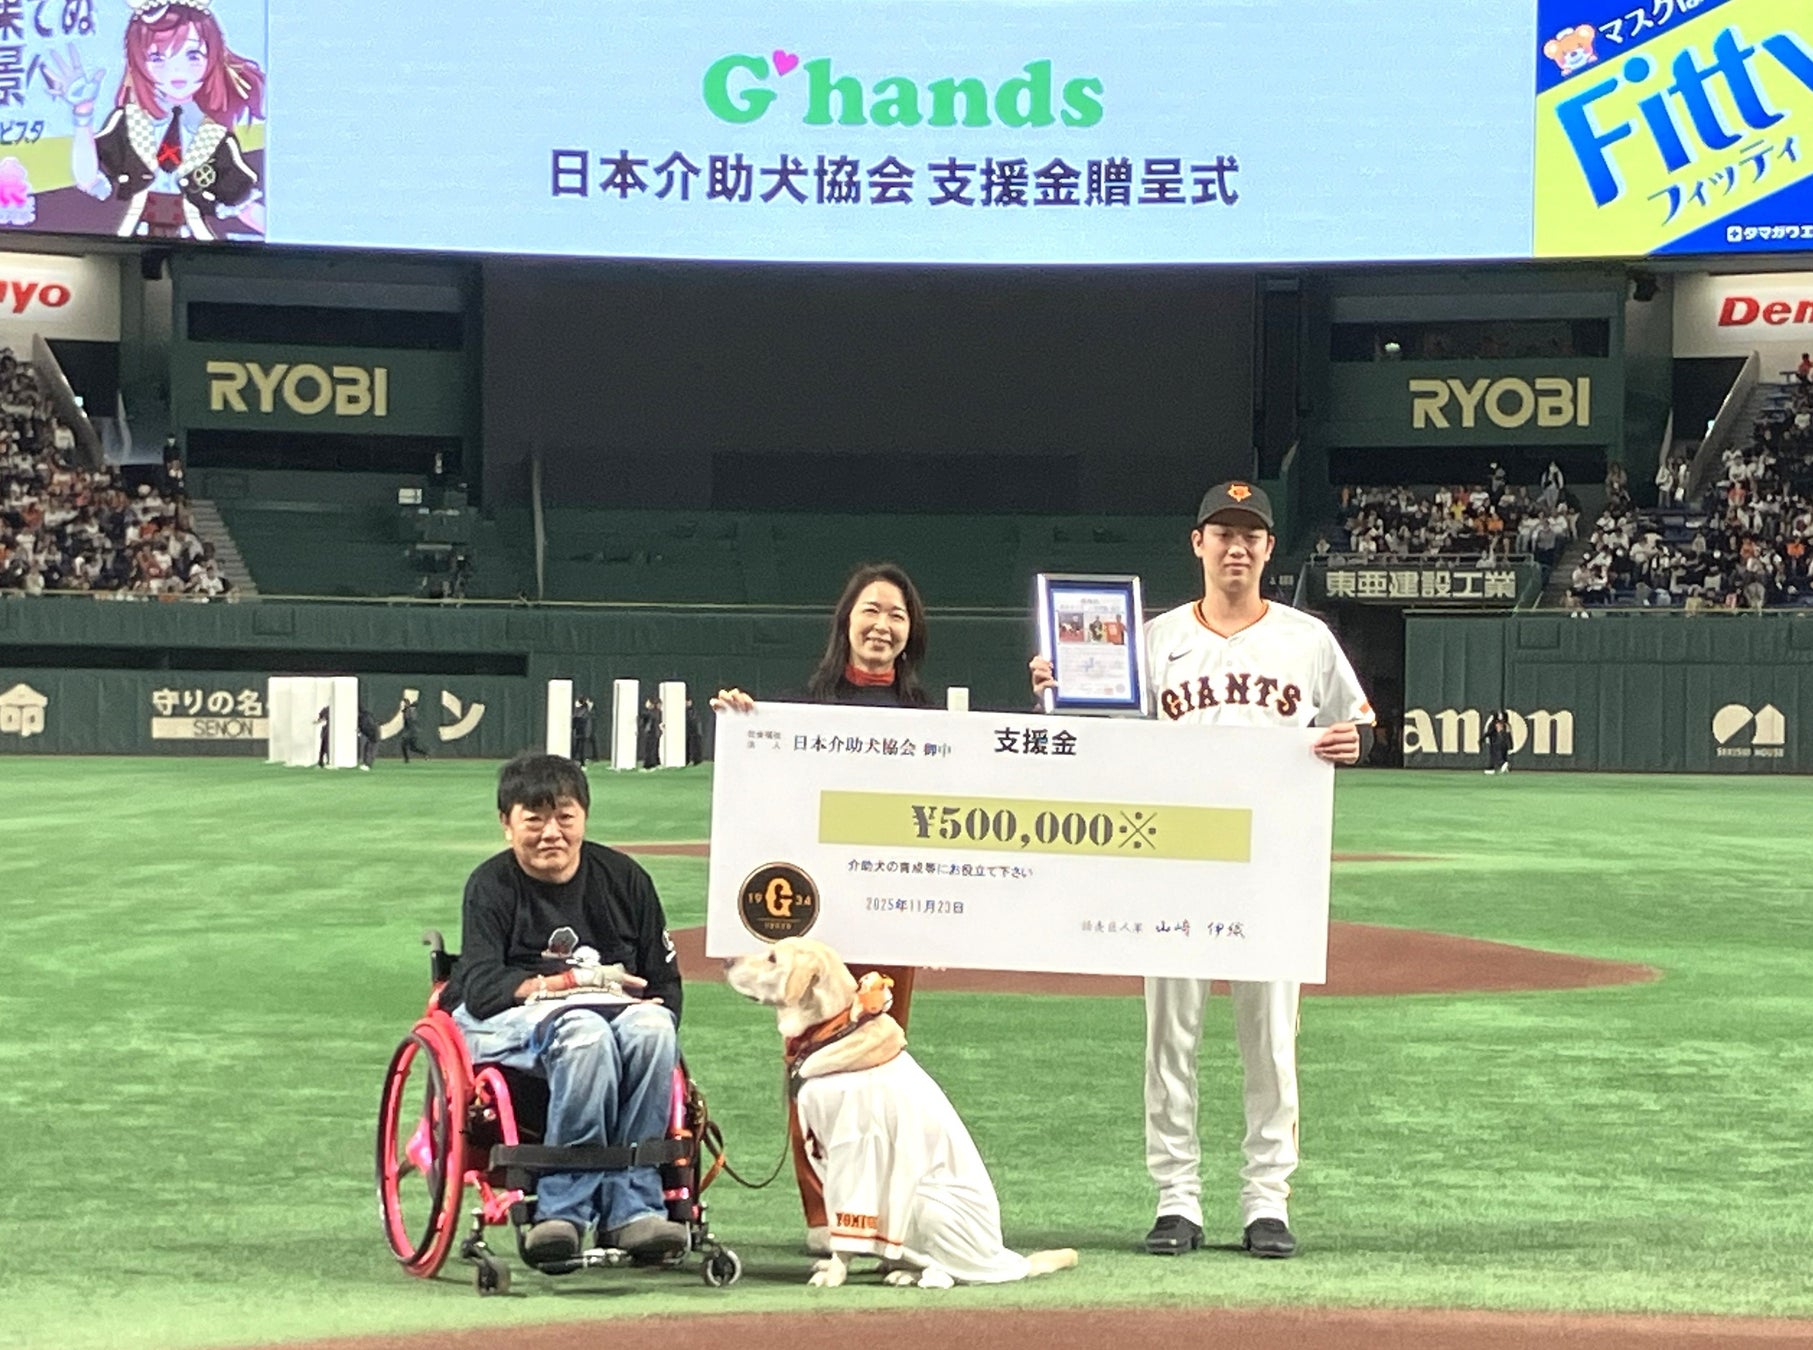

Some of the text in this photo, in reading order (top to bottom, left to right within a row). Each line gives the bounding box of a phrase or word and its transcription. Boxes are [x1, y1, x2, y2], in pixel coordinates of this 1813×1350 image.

[802, 59, 1105, 128] hands
[550, 149, 1240, 207] 日本介助犬協会 支援金贈呈式
[1648, 136, 1798, 226] フィッティ
[0, 281, 71, 313] yo
[206, 361, 387, 417] RYOBI
[1409, 377, 1590, 429] RYOBI
[1326, 571, 1516, 598] 東亜建設工業
[152, 690, 269, 716] 守りの名
[1161, 673, 1301, 720] GIANTS
[193, 720, 254, 737] SENON
[793, 735, 916, 757] 日本介助犬協会
[994, 726, 1078, 755] 支援金
[765, 877, 793, 917] G
